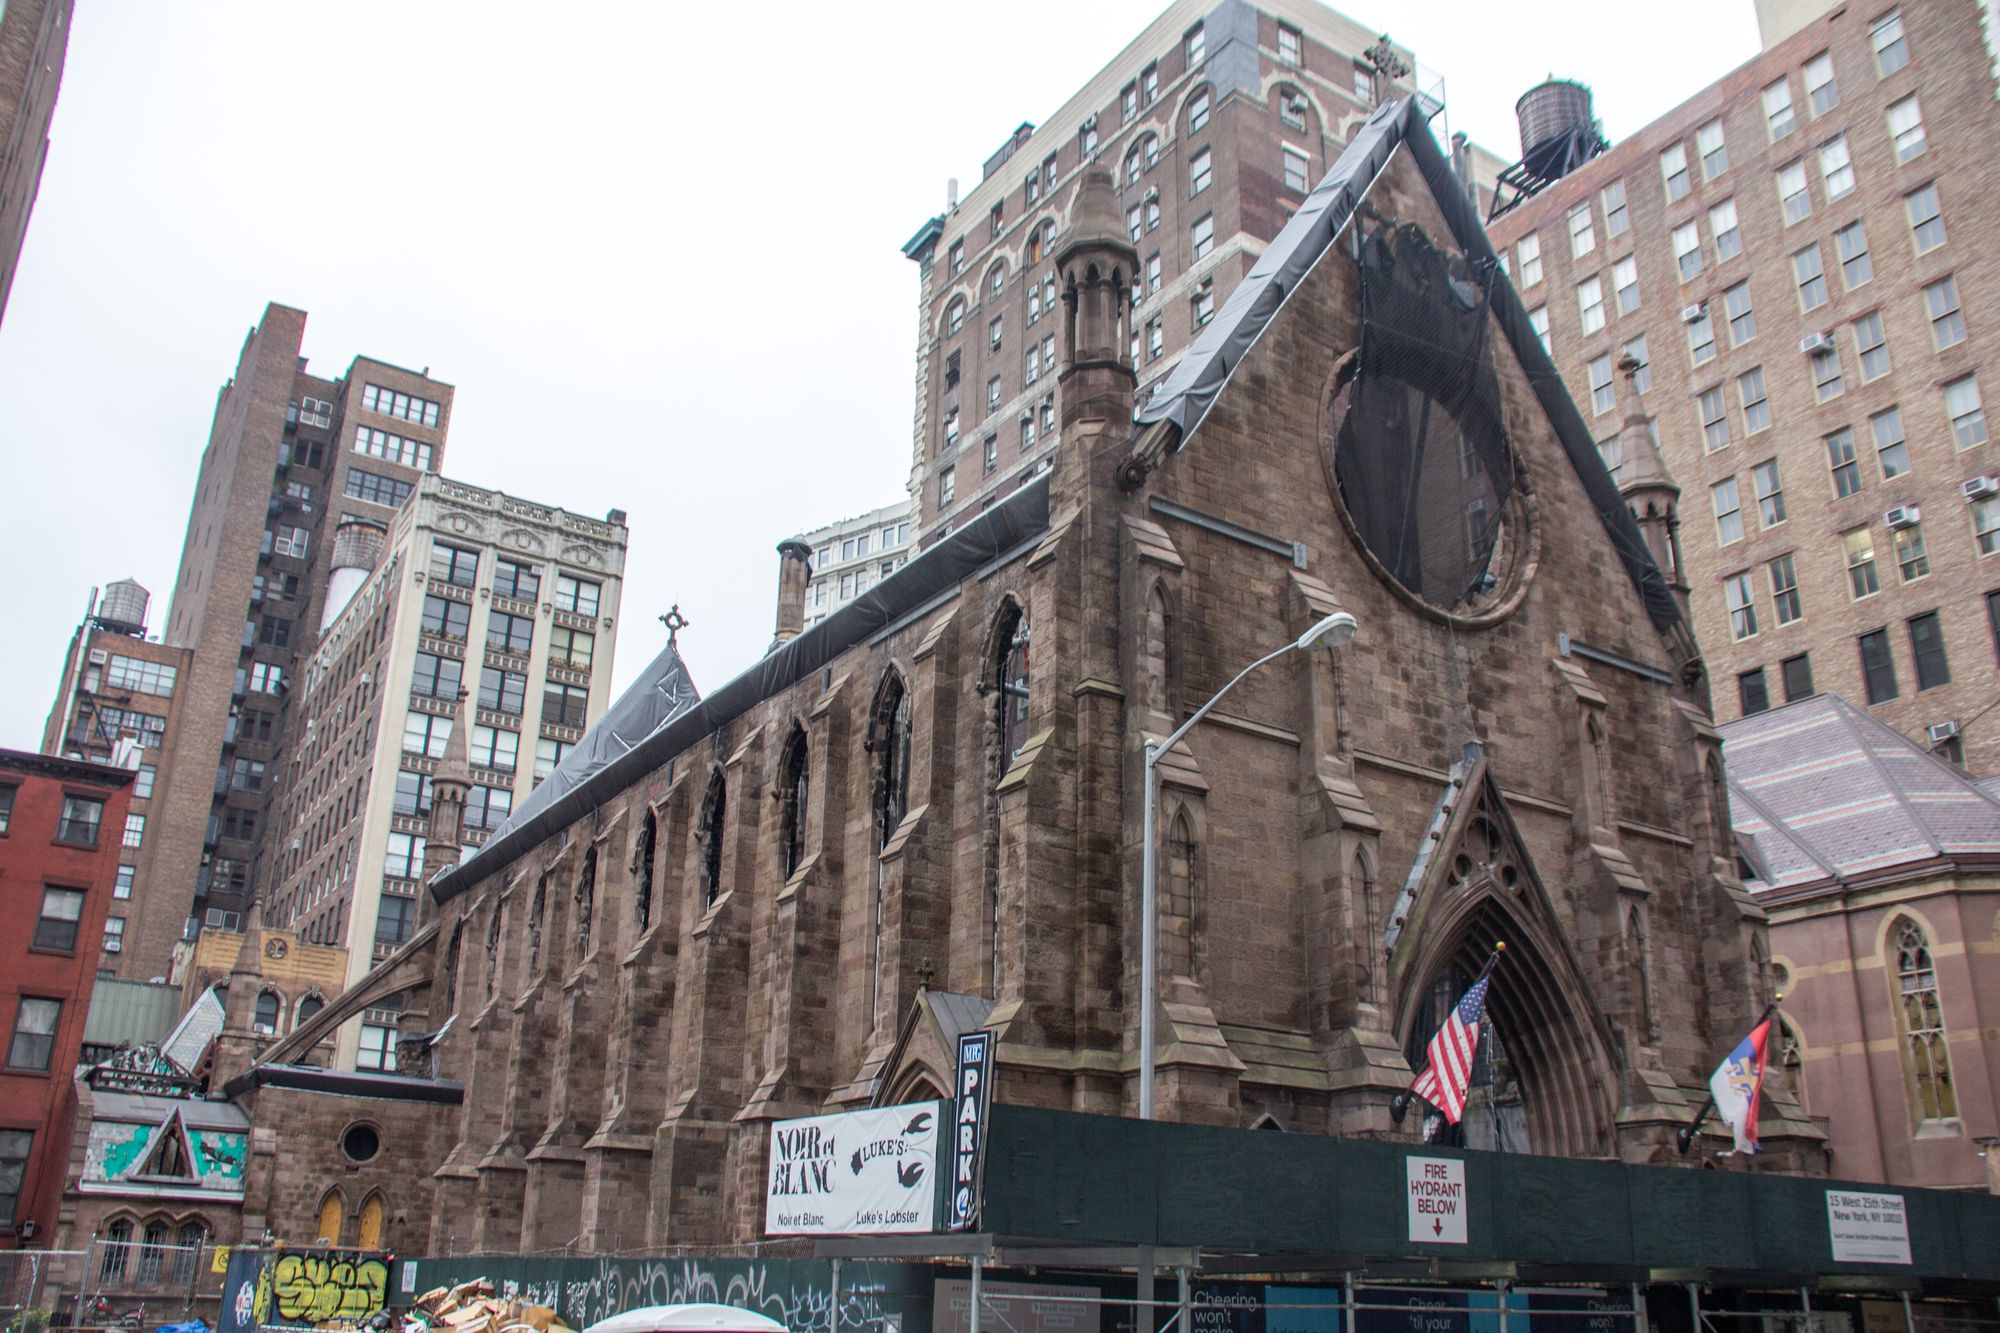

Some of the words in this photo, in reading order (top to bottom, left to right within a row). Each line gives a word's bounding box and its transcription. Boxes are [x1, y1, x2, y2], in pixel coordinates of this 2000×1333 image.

[959, 1069, 978, 1182] PARK
[777, 1126, 821, 1161] NOIR
[823, 1134, 836, 1157] et
[772, 1159, 837, 1196] BLANC
[1424, 1163, 1448, 1179] FIRE
[1411, 1180, 1462, 1198] HYDRANT
[1418, 1199, 1456, 1215] BELOW
[1830, 1195, 1840, 1207] 15
[1841, 1196, 1861, 1208] West
[778, 1213, 792, 1226] Noir
[794, 1214, 801, 1226] et
[803, 1212, 824, 1226] Blanc
[856, 1210, 883, 1225] Luke's
[885, 1210, 919, 1224] Lobster
[1834, 1210, 1850, 1220] New
[1194, 1291, 1257, 1312] Cheering
[1194, 1308, 1231, 1324] won't
[1426, 1318, 1452, 1333] your
